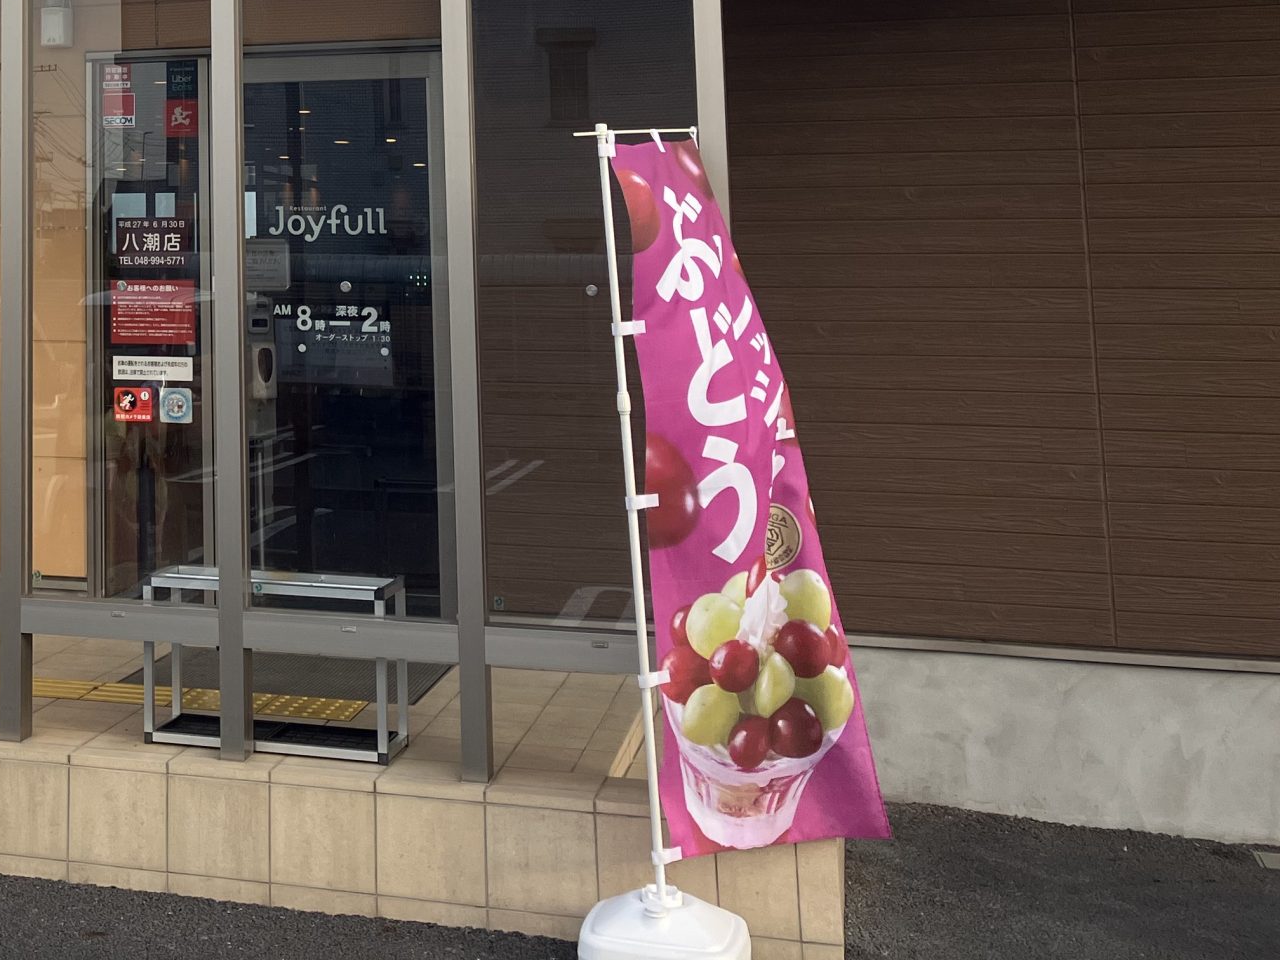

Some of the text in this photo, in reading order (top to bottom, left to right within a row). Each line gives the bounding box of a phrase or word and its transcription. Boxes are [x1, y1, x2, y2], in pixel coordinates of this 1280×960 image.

[171, 74, 192, 83] Uber
[104, 117, 133, 125] SECOM
[269, 204, 387, 242] Joyfull
[122, 232, 181, 251] 八潮店
[119, 256, 185, 265] TEL 048-994-5771
[273, 304, 292, 316] AM
[655, 185, 758, 565] ぶどう
